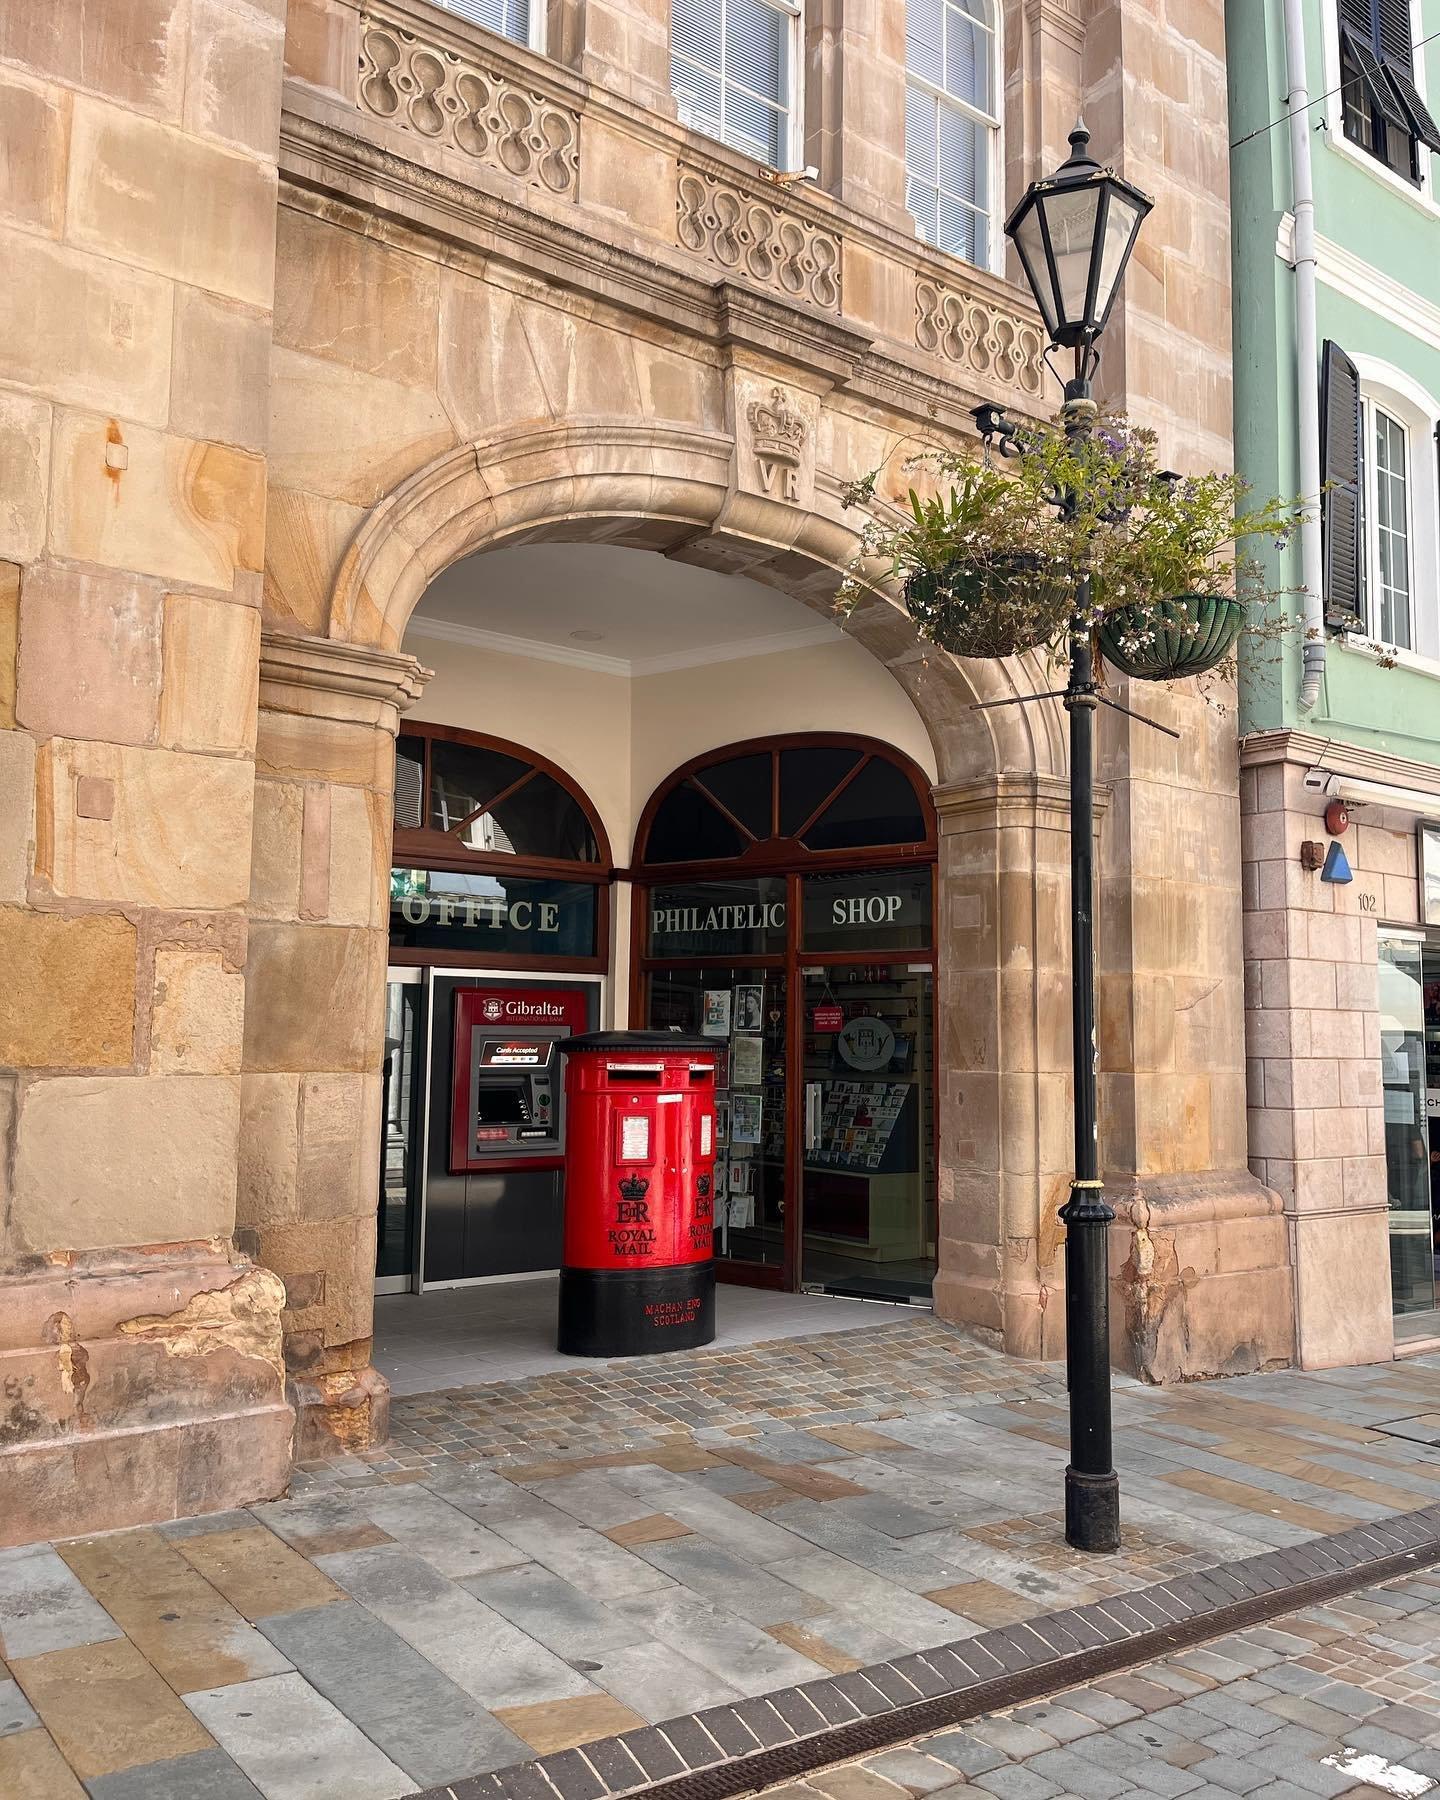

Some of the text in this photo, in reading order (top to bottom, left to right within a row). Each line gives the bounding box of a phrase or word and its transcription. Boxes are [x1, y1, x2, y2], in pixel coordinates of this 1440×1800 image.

[1358, 893, 1376, 912] 102
[402, 893, 559, 932] OFFICE
[652, 895, 903, 934] PHILATELIC SHOP
[505, 1001, 565, 1016] Gibraltar
[512, 1047, 538, 1055] Accepted
[608, 1229, 656, 1243] ROYAL
[614, 1243, 652, 1255] MAIL
[645, 1302, 683, 1315] MACHAN
[654, 1312, 695, 1326] SCOTLAND
